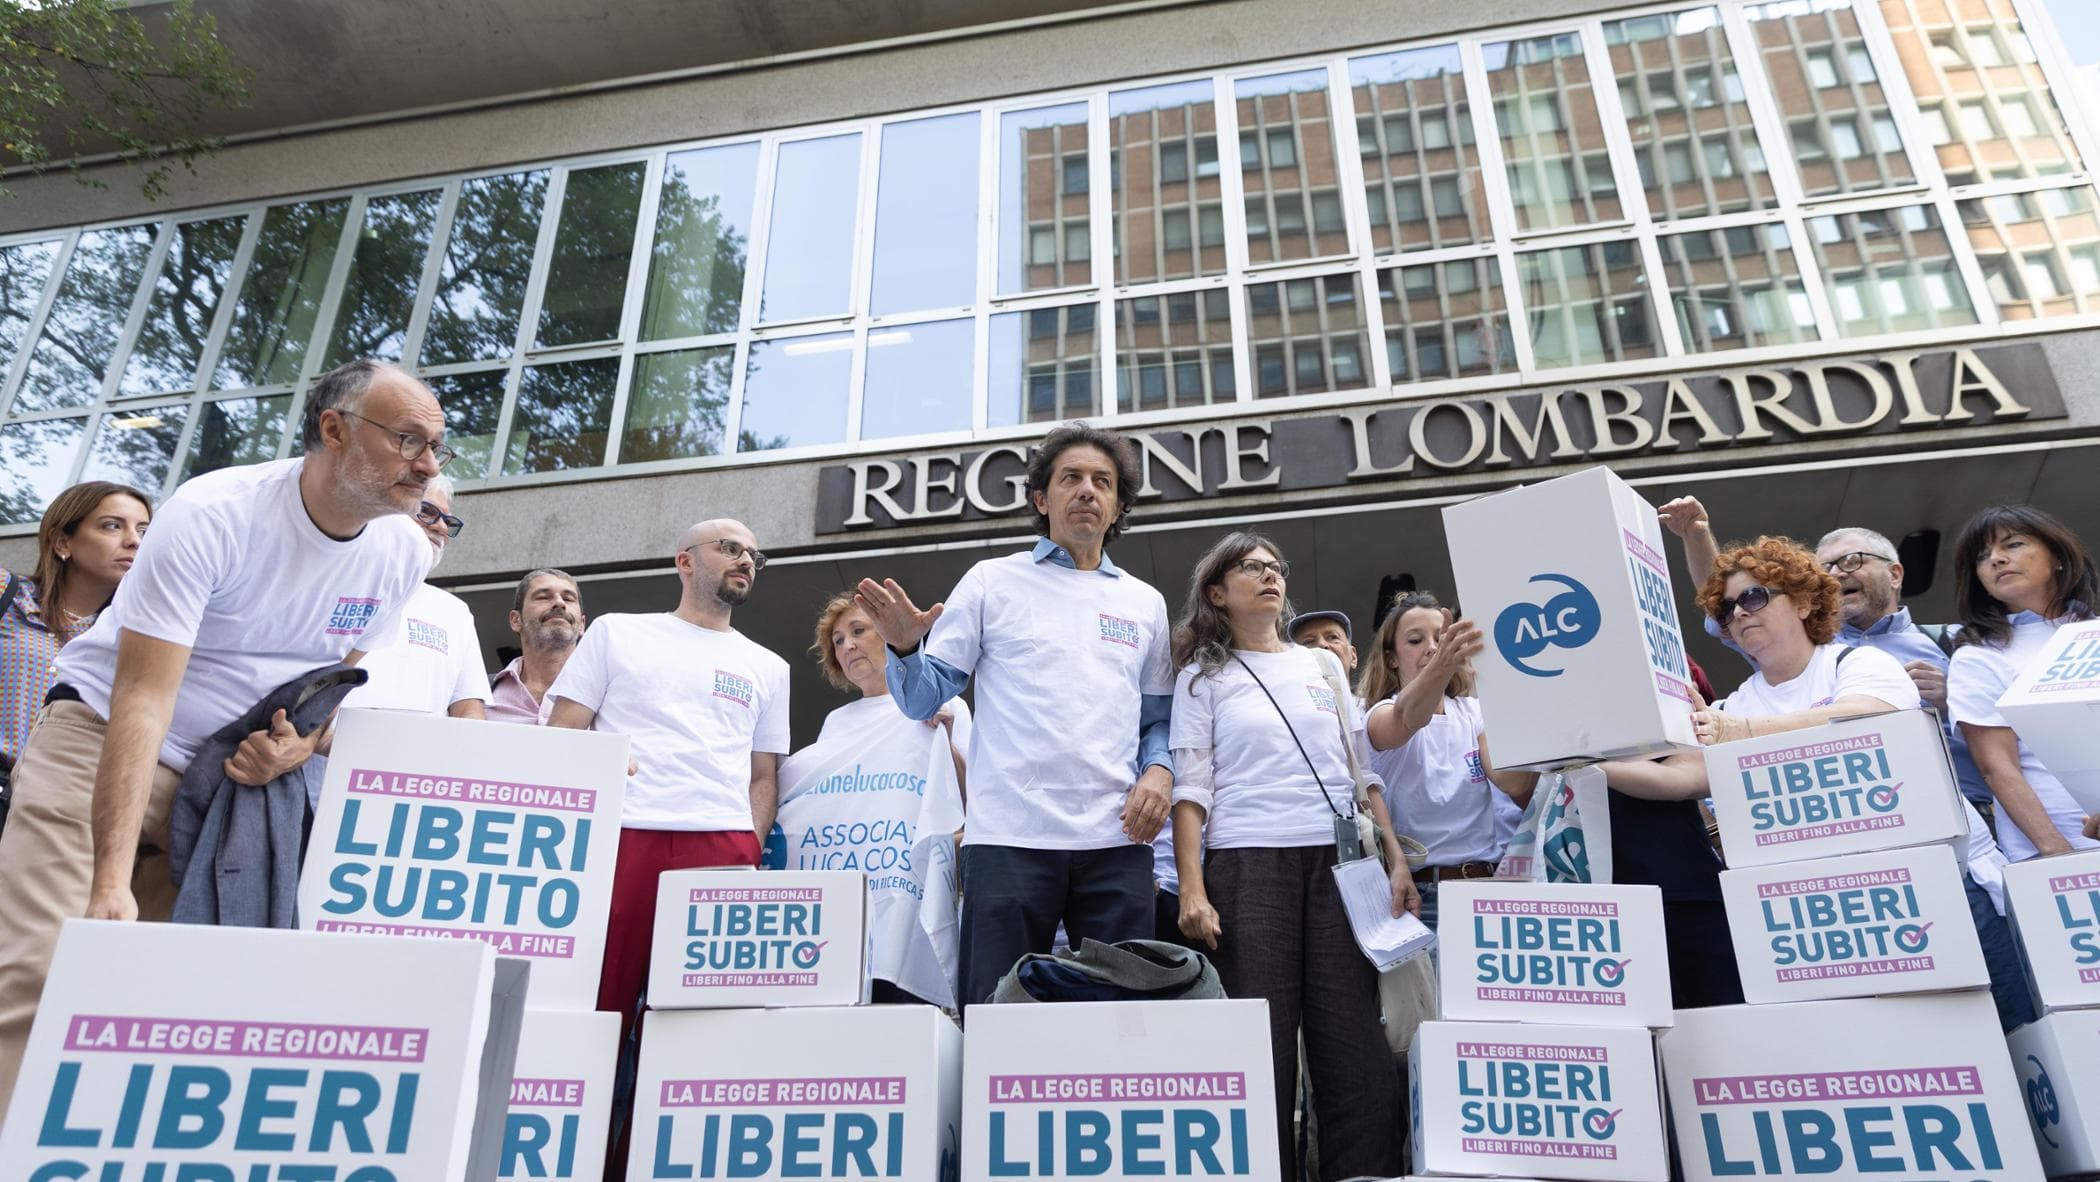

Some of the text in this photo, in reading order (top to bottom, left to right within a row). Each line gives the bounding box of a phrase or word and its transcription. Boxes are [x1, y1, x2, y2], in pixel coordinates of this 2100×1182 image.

[843, 348, 2030, 528] REGNE LOMBARDIA
[1629, 556, 1677, 630] LIBERI
[1099, 618, 1138, 635] LIBERI
[1514, 606, 1582, 643] ALC
[1644, 617, 1686, 679] SUBITO
[713, 683, 753, 703] SUBITO
[714, 673, 753, 694] LIBERI
[1741, 735, 1881, 768] LA LEGGE REGIONALE
[1740, 748, 1892, 801] LIBERI
[356, 773, 592, 810] LA LEGGE REGIONALE
[1750, 784, 1900, 831] SUBITO
[334, 798, 592, 872] LIBERI
[800, 820, 916, 849] ASSOCIA
[1758, 815, 1902, 846] LIBERI FINO ALLA FINE
[320, 862, 580, 929] SUBITO
[692, 889, 820, 901] LA LEGGE REGIONALE
[869, 878, 879, 891] DI
[1762, 869, 1910, 897] LA LEGGE REGIONALE
[2054, 879, 2076, 891] LA
[686, 903, 821, 937] LIBERI
[1477, 901, 1616, 917] LA LEGGE REGIONALE
[1760, 884, 1921, 932] LIBERI
[520, 937, 569, 954] FINE
[1473, 915, 1622, 953] LIBERI
[1770, 923, 1930, 966] SUBITO
[684, 940, 822, 970] SUBITO
[1476, 953, 1626, 988] SUBITO
[1780, 957, 1932, 982] LIBERI FINO ALLA FINE
[685, 973, 816, 986] LIBERI FINO ALLA FINE
[1480, 988, 1623, 1005] LIBERI FINO ALLA FINE
[76, 1021, 422, 1058] LA LEGGE REGIONALE
[1460, 1044, 1605, 1061] LA LEGGE REGIONALE
[667, 1081, 900, 1103] LA LEGGE REGIONALE
[996, 1076, 1240, 1099] LA LEGGE REGIONALE
[1457, 1060, 1612, 1102] LIBERI
[1701, 1070, 1976, 1102] LA LEGGE REGIONALE
[37, 1061, 421, 1154] LIBERI
[1461, 1101, 1616, 1140] SUBITO
[652, 1112, 904, 1179] LIBERI
[989, 1108, 1250, 1177] LIBERI
[1465, 1139, 1614, 1158] LIBERI FINO ALLA FINE
[1700, 1102, 2004, 1176] LIBERI
